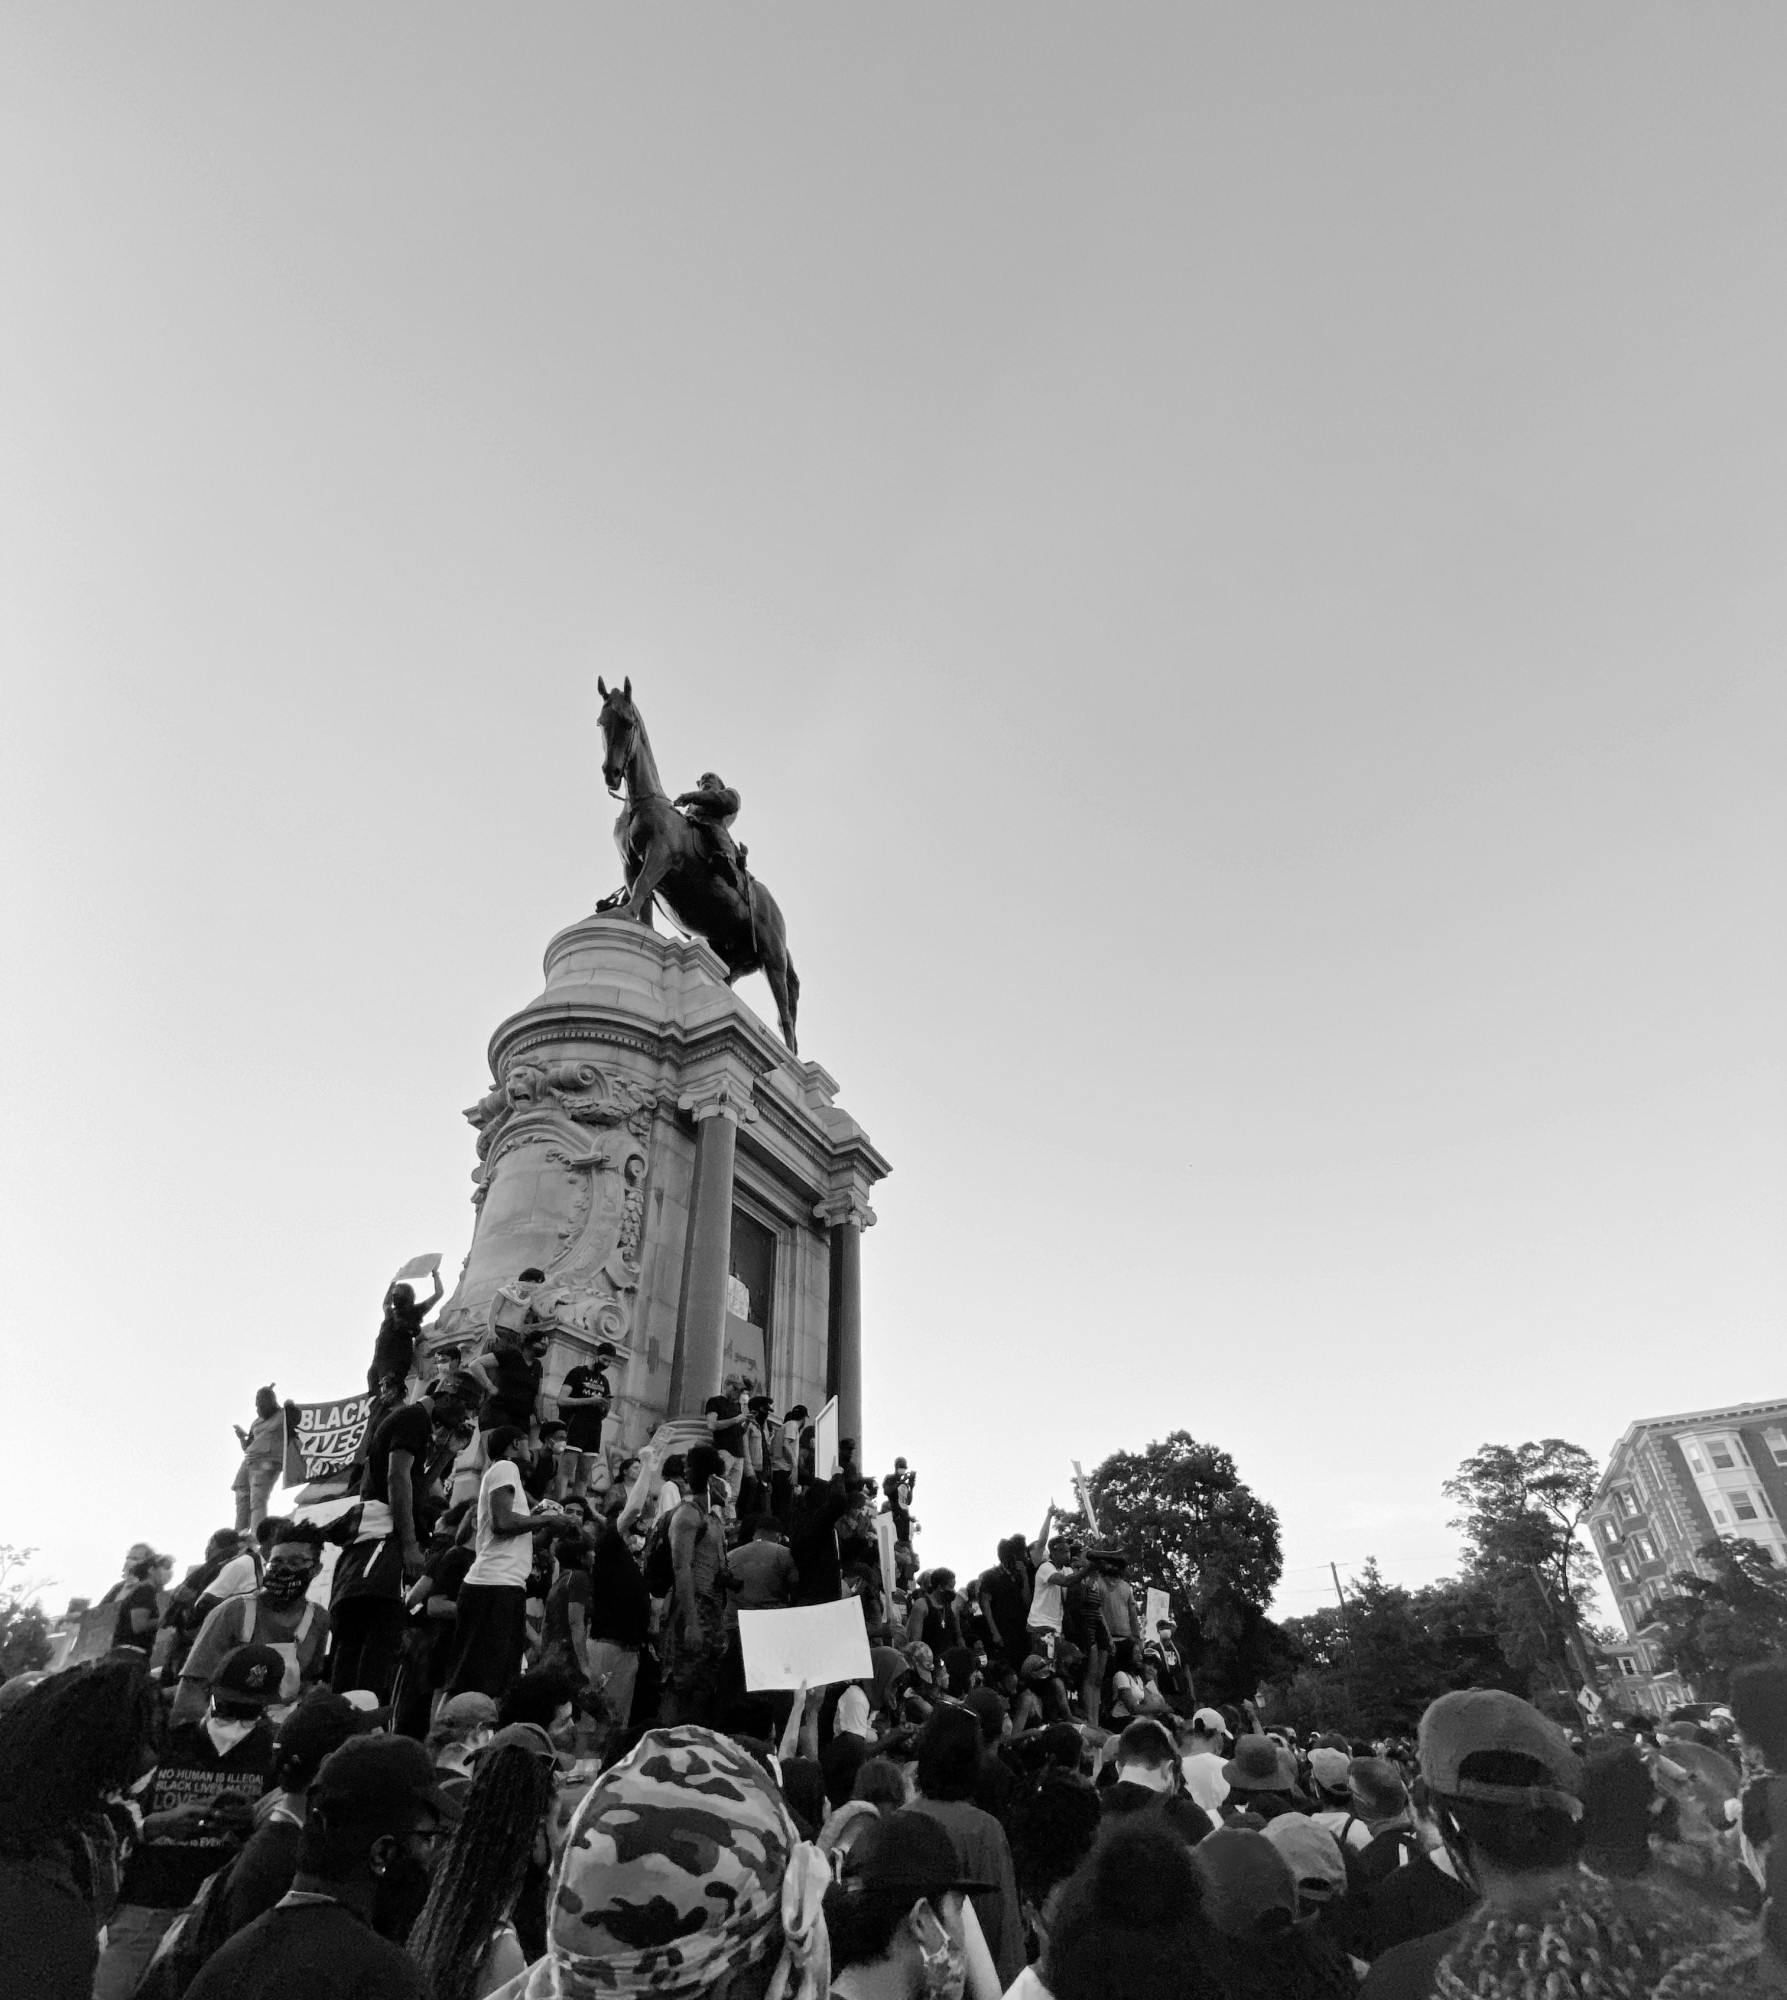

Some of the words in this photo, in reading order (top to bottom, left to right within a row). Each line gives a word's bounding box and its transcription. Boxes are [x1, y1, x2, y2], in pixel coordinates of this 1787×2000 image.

[298, 1396, 376, 1431] BLACK
[158, 1768, 175, 1779] NO
[176, 1769, 214, 1783] HUMAN
[215, 1772, 225, 1783] IS
[155, 1780, 192, 1792] BLACK
[194, 1783, 224, 1794] LIVES
